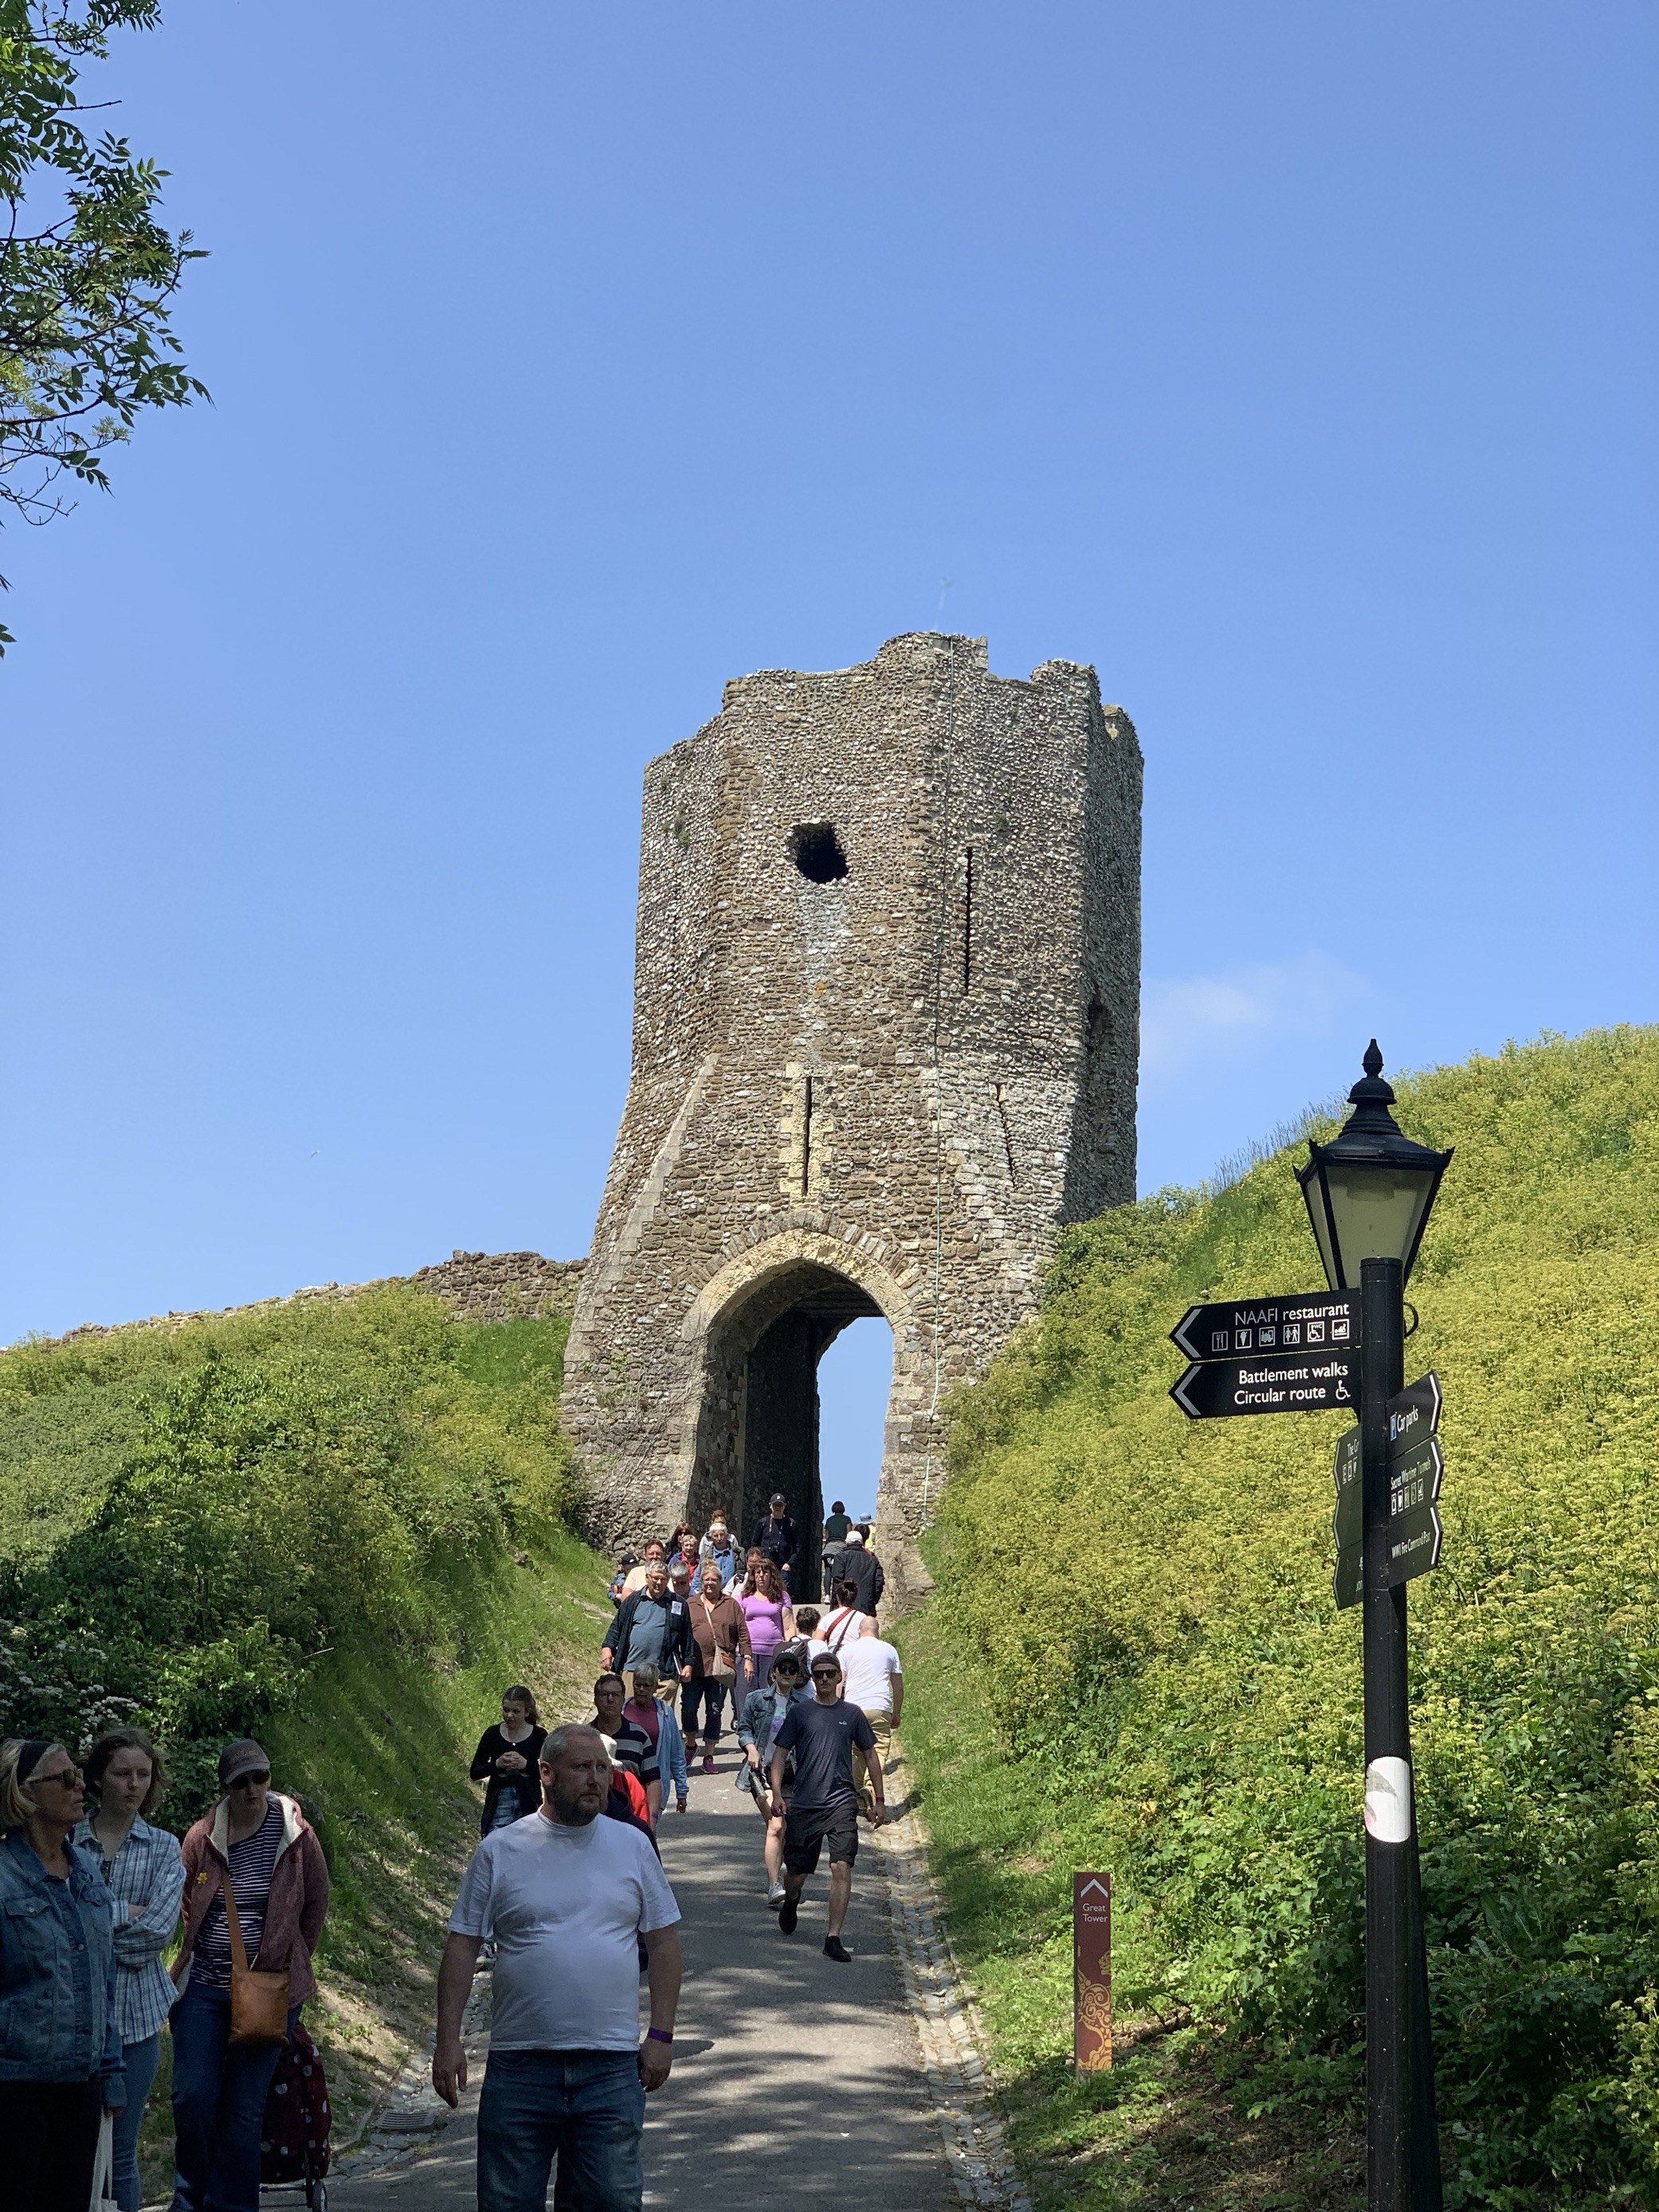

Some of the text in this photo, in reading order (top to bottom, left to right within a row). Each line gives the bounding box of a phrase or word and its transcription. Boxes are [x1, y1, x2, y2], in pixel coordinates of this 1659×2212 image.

[1235, 1304, 1349, 1325] NAAFI restaurant
[1239, 1362, 1348, 1384] Battlement walks
[1234, 1386, 1326, 1405] Circular route
[1397, 1414, 1406, 1433] Car
[1406, 1405, 1418, 1433] parks
[1082, 1903, 1106, 1912] Great
[1082, 1913, 1108, 1922] Tower
